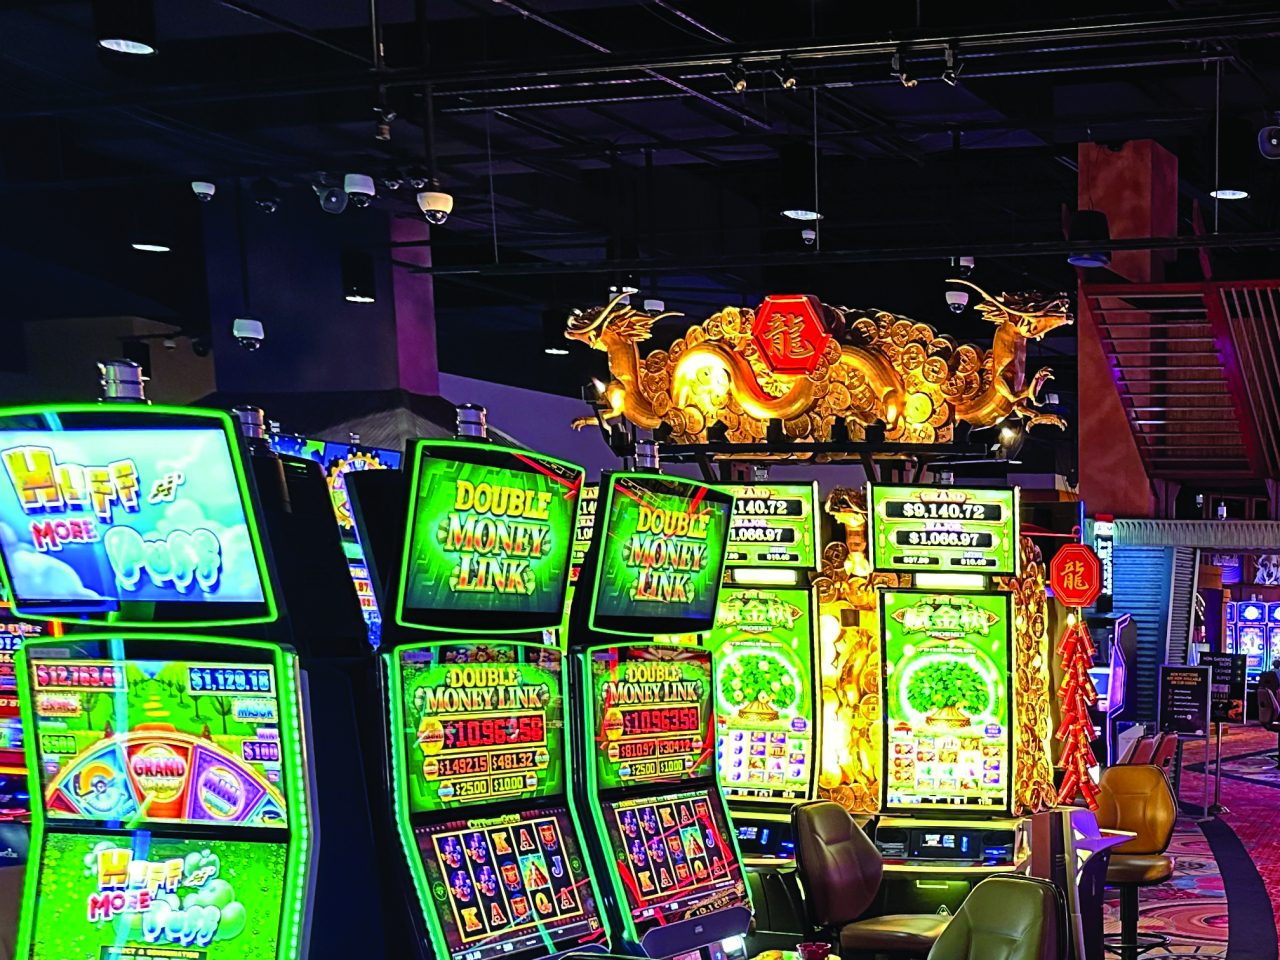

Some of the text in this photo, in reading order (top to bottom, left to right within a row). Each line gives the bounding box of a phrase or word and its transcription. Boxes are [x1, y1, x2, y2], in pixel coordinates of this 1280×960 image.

[766, 311, 811, 360] 龍
[455, 480, 552, 520] DOUBLE
[903, 503, 985, 518] $9,140.72
[28, 518, 99, 552] MORE
[444, 513, 550, 559] MONEY
[637, 506, 710, 538] DOUBLE
[627, 534, 707, 571] MONEY
[456, 553, 530, 594] LINK
[634, 567, 691, 602] LINK
[1060, 559, 1089, 591] 龍
[451, 667, 518, 688] DOUBLE
[628, 665, 680, 682] DOUBLE
[424, 685, 542, 713] MONEY LINK
[610, 680, 698, 704] MONEY LINK
[133, 755, 186, 778] GRAND
[243, 742, 279, 760] $100
[88, 891, 152, 923] MORE
